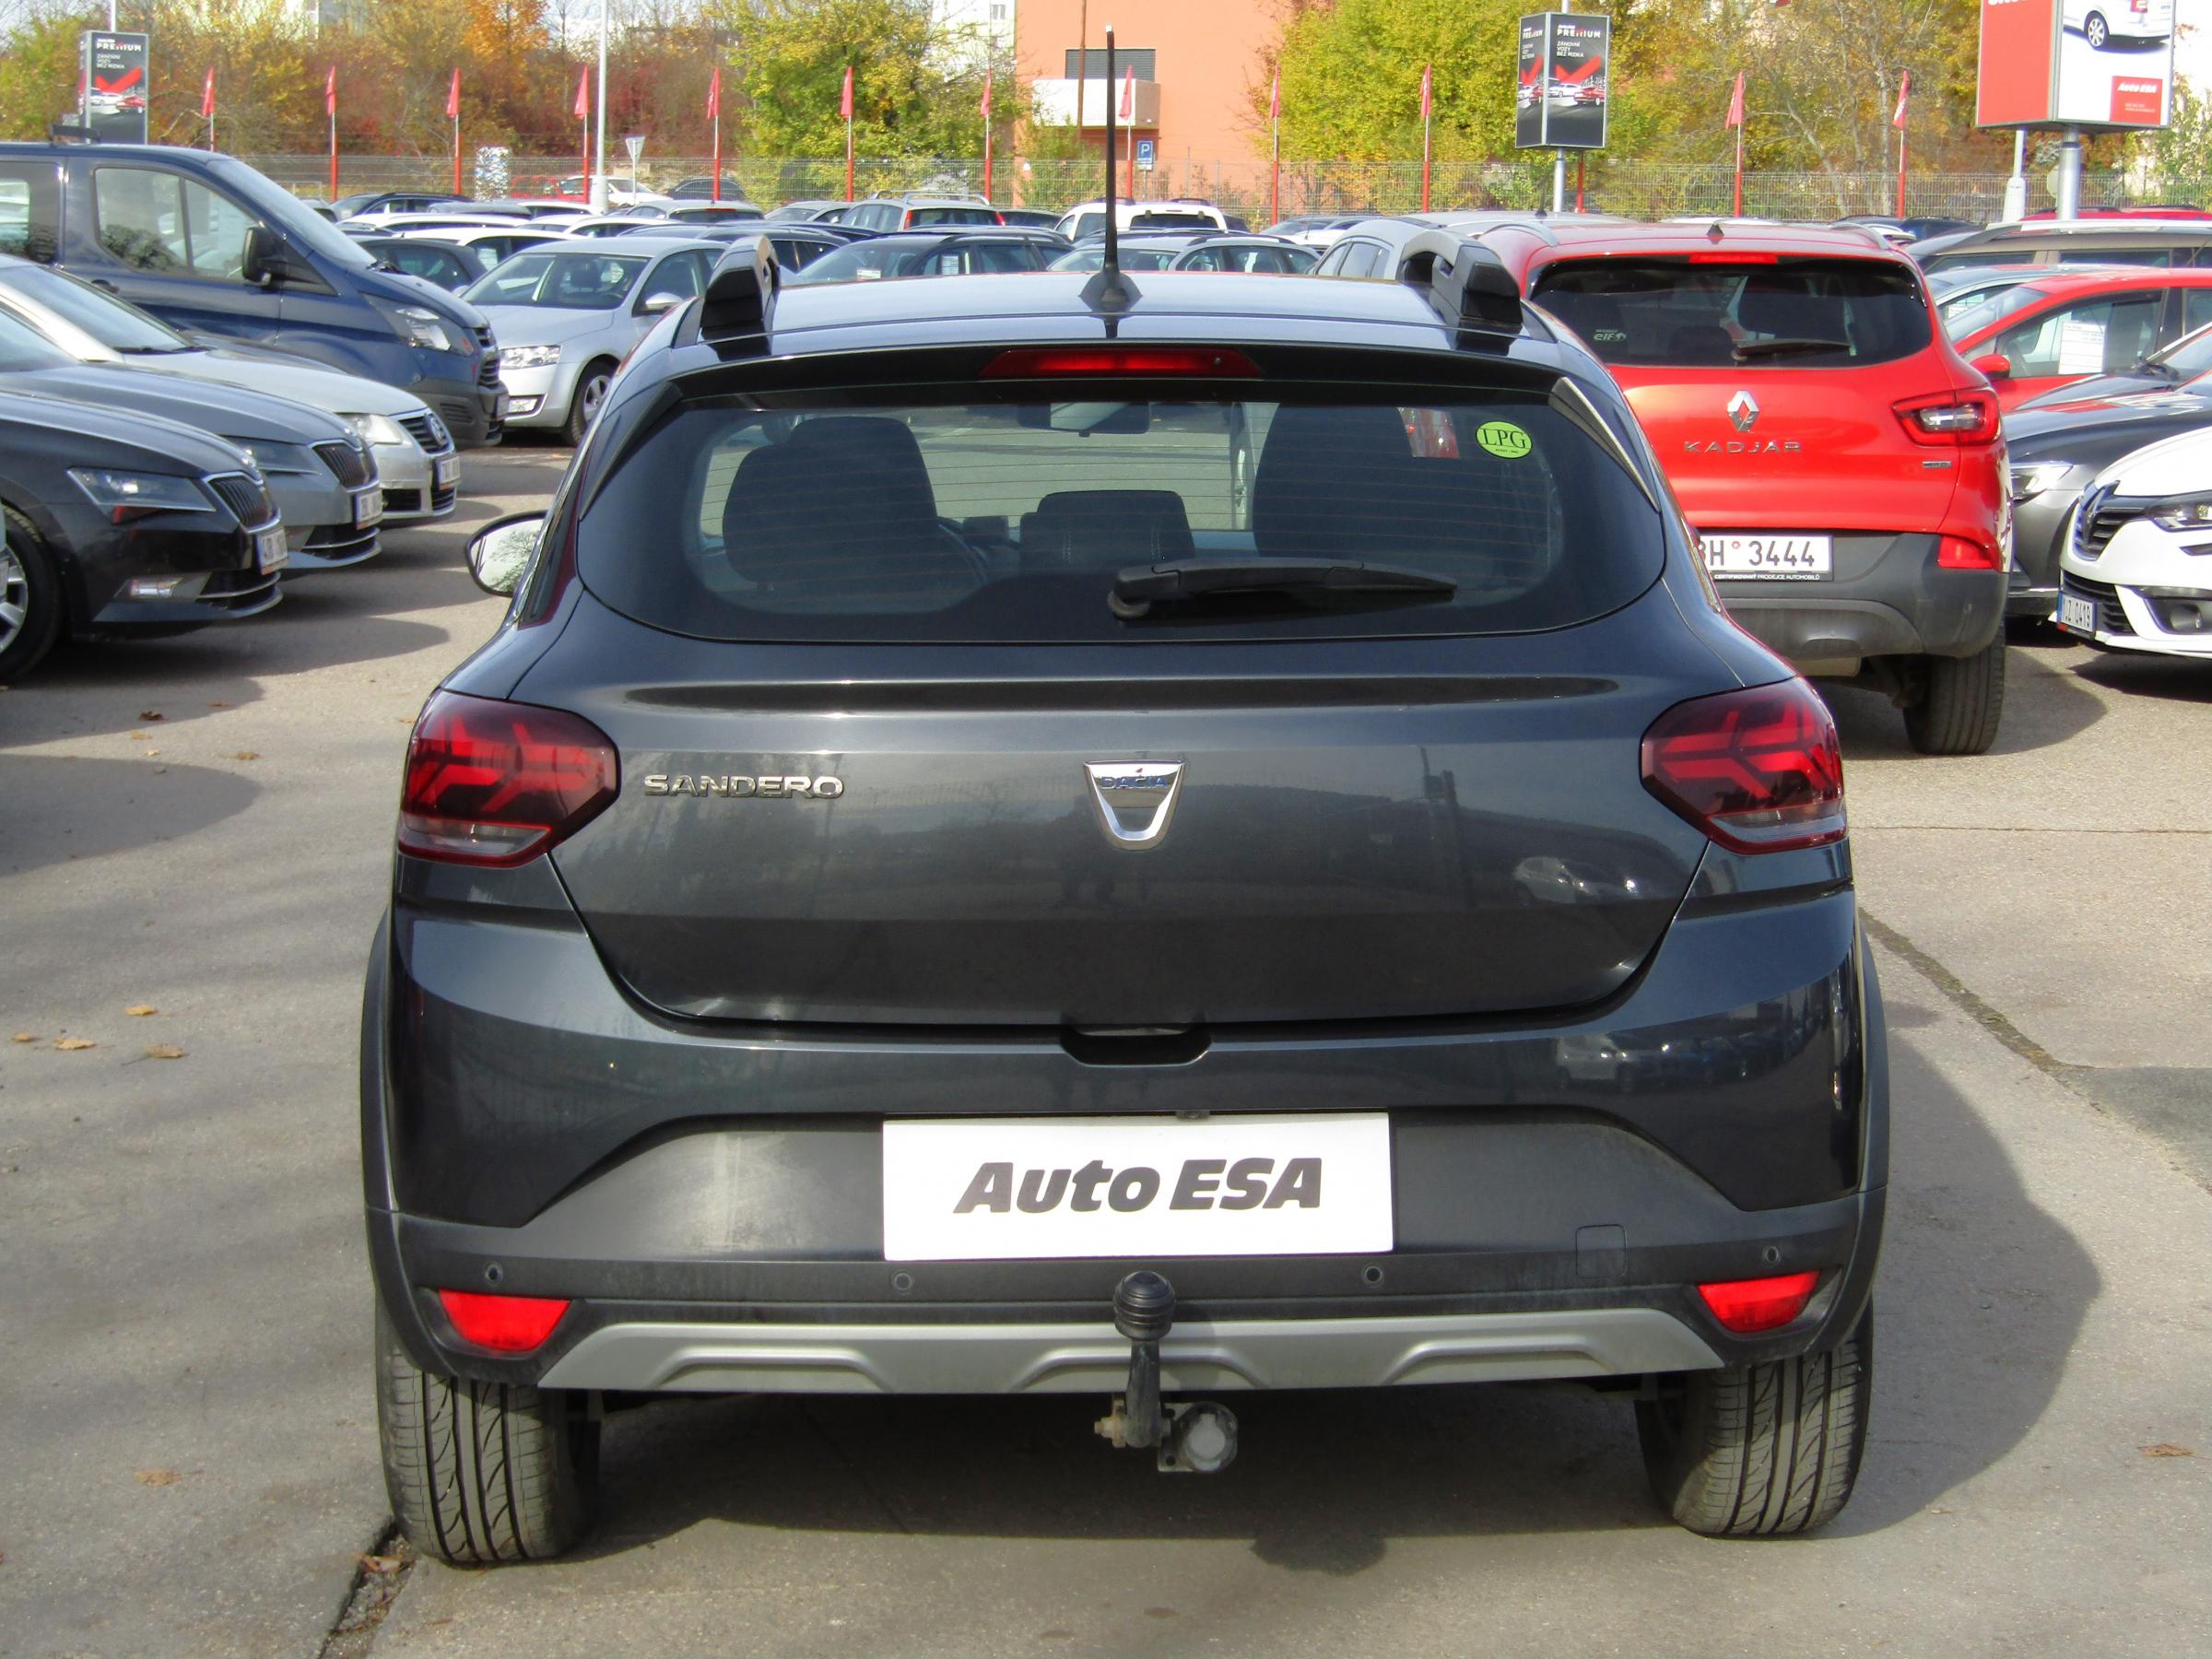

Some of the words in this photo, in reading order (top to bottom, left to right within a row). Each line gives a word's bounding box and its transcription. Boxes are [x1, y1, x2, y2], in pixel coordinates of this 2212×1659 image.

[1141, 144, 1150, 155] P
[1479, 429, 1526, 449] LPG
[1683, 441, 1801, 453] KADJAR
[1748, 540, 1815, 567] 3444
[644, 774, 844, 799] SANDERO
[952, 1159, 1160, 1214] Auto
[1169, 1157, 1323, 1211] ESA
